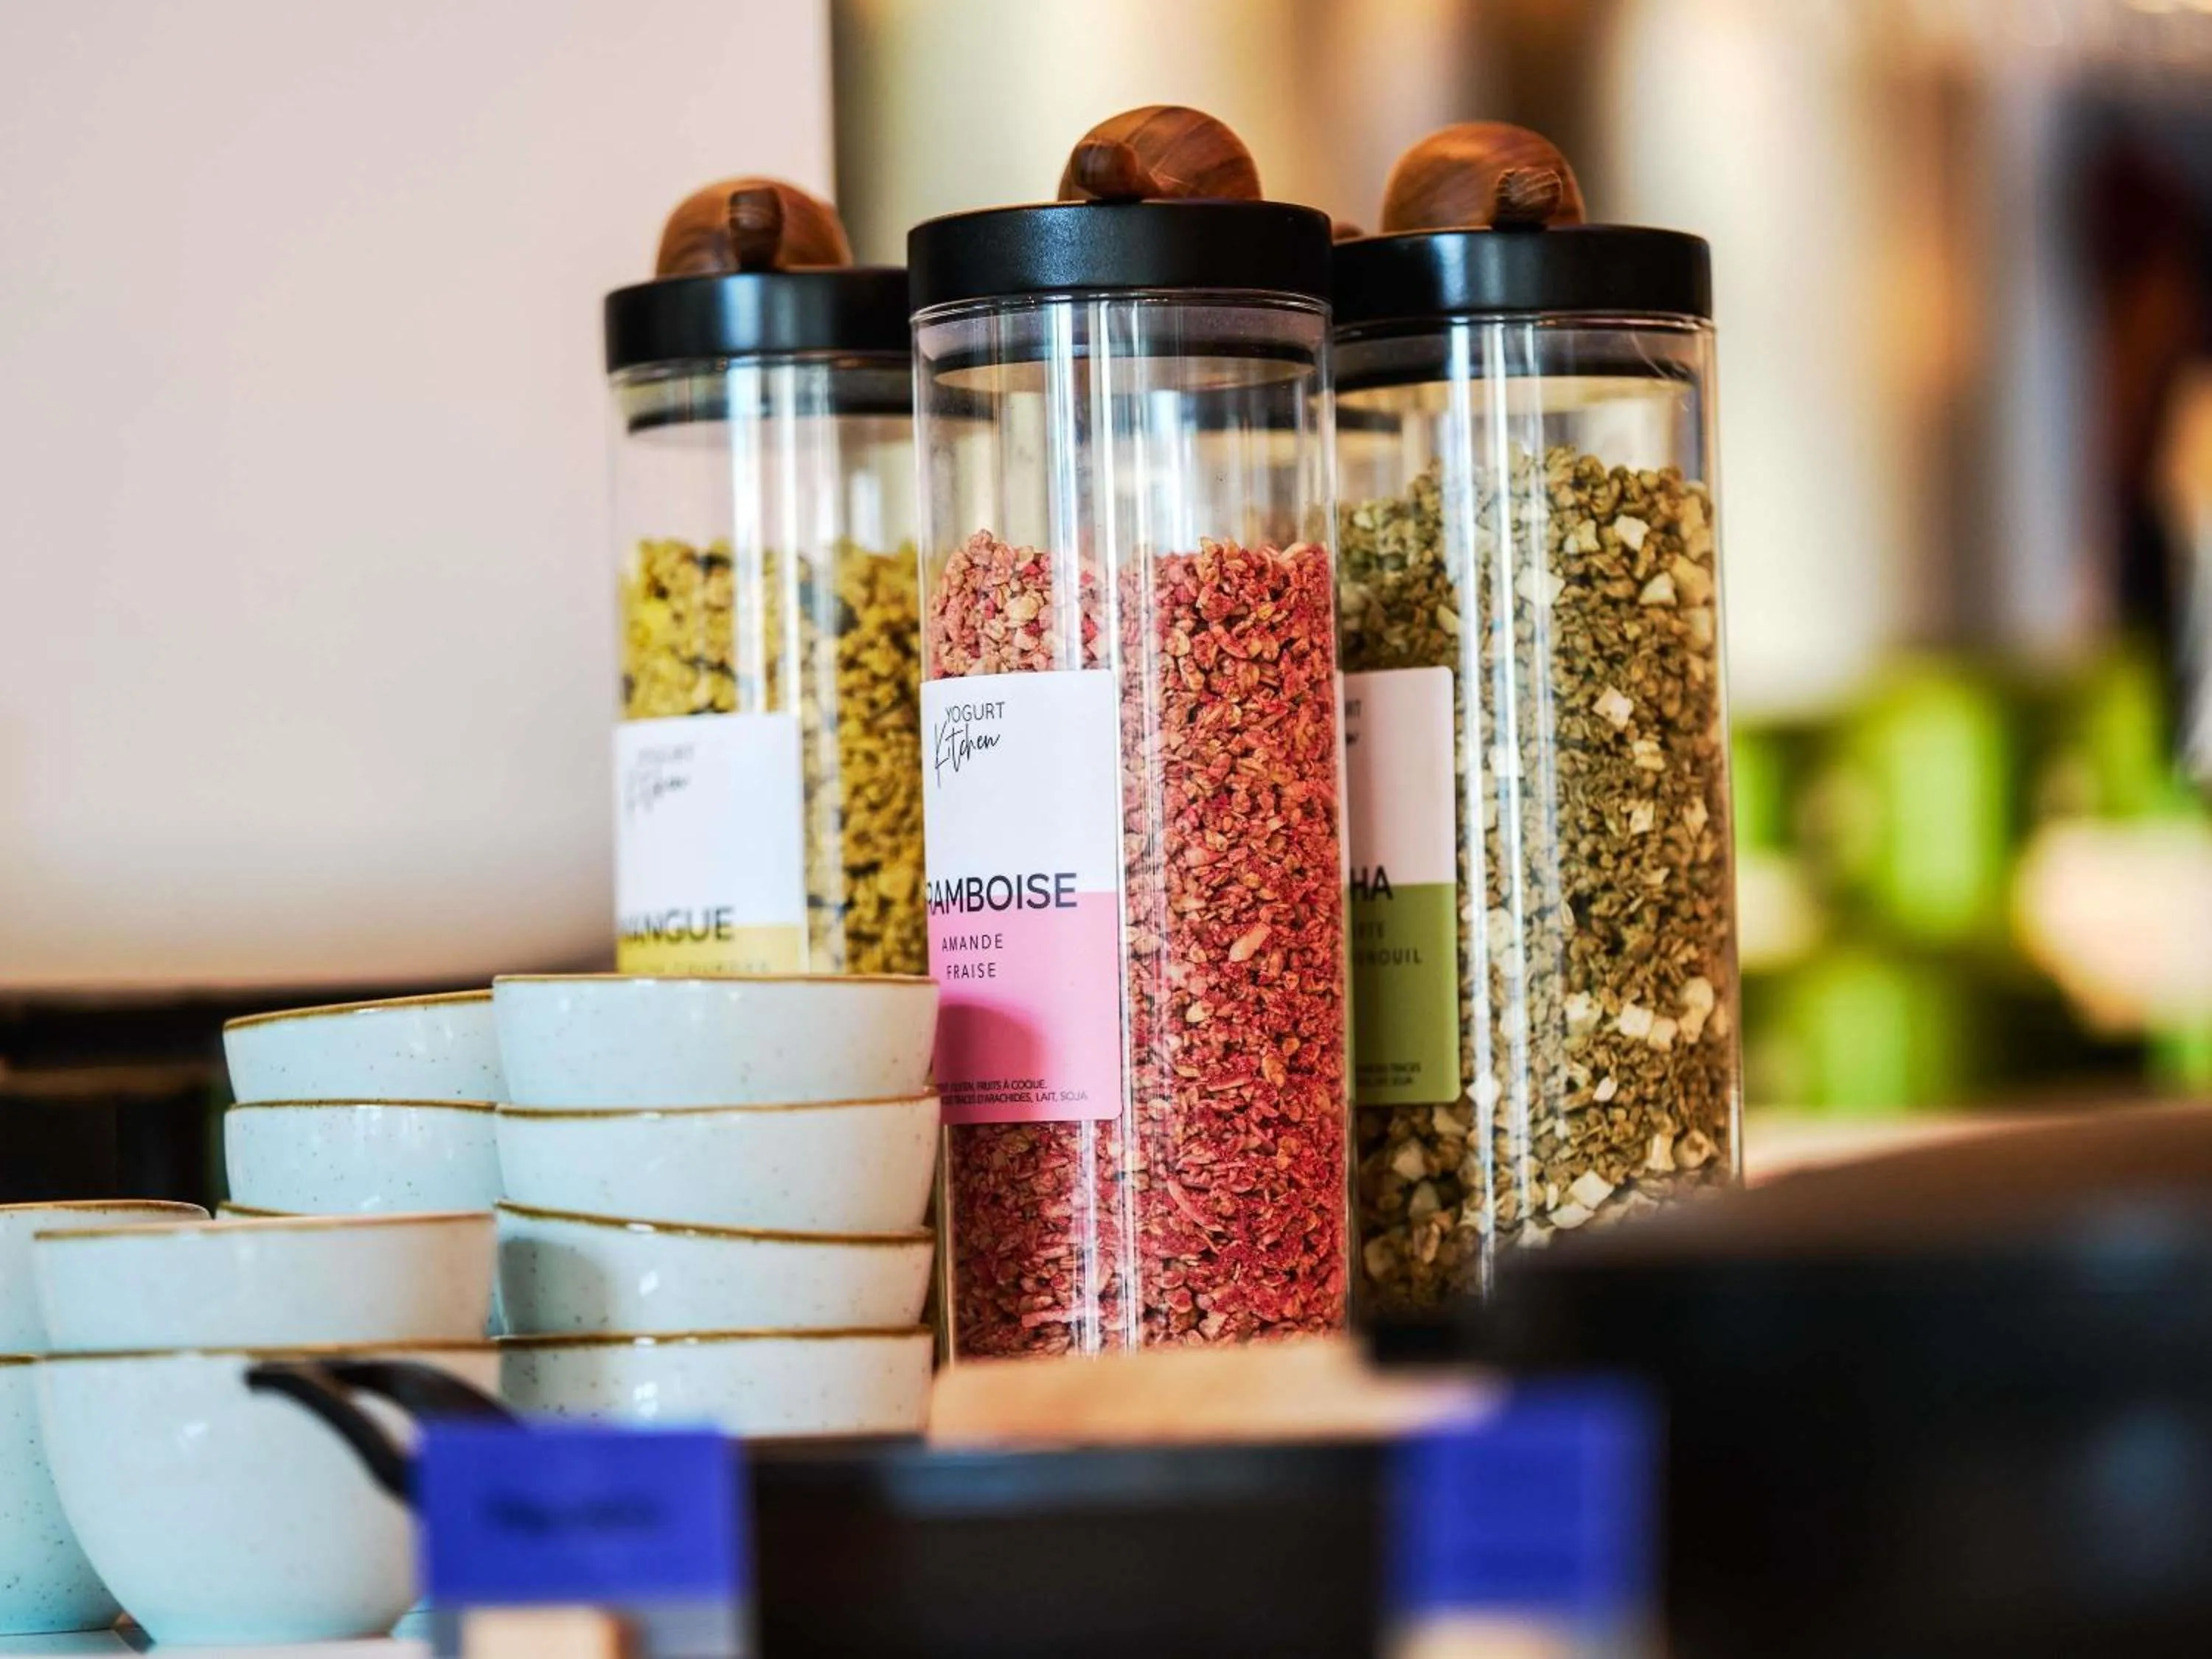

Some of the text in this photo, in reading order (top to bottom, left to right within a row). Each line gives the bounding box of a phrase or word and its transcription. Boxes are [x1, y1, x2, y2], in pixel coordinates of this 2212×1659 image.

[945, 701, 1006, 723] YOGURT
[934, 720, 1001, 788] Kitchen
[942, 933, 1004, 952] AMANDE
[946, 962, 997, 980] FRAISE
[1011, 1079, 1048, 1091] COQUE.
[1035, 1092, 1058, 1103] LAIT,
[1060, 1091, 1088, 1102] SOJA
